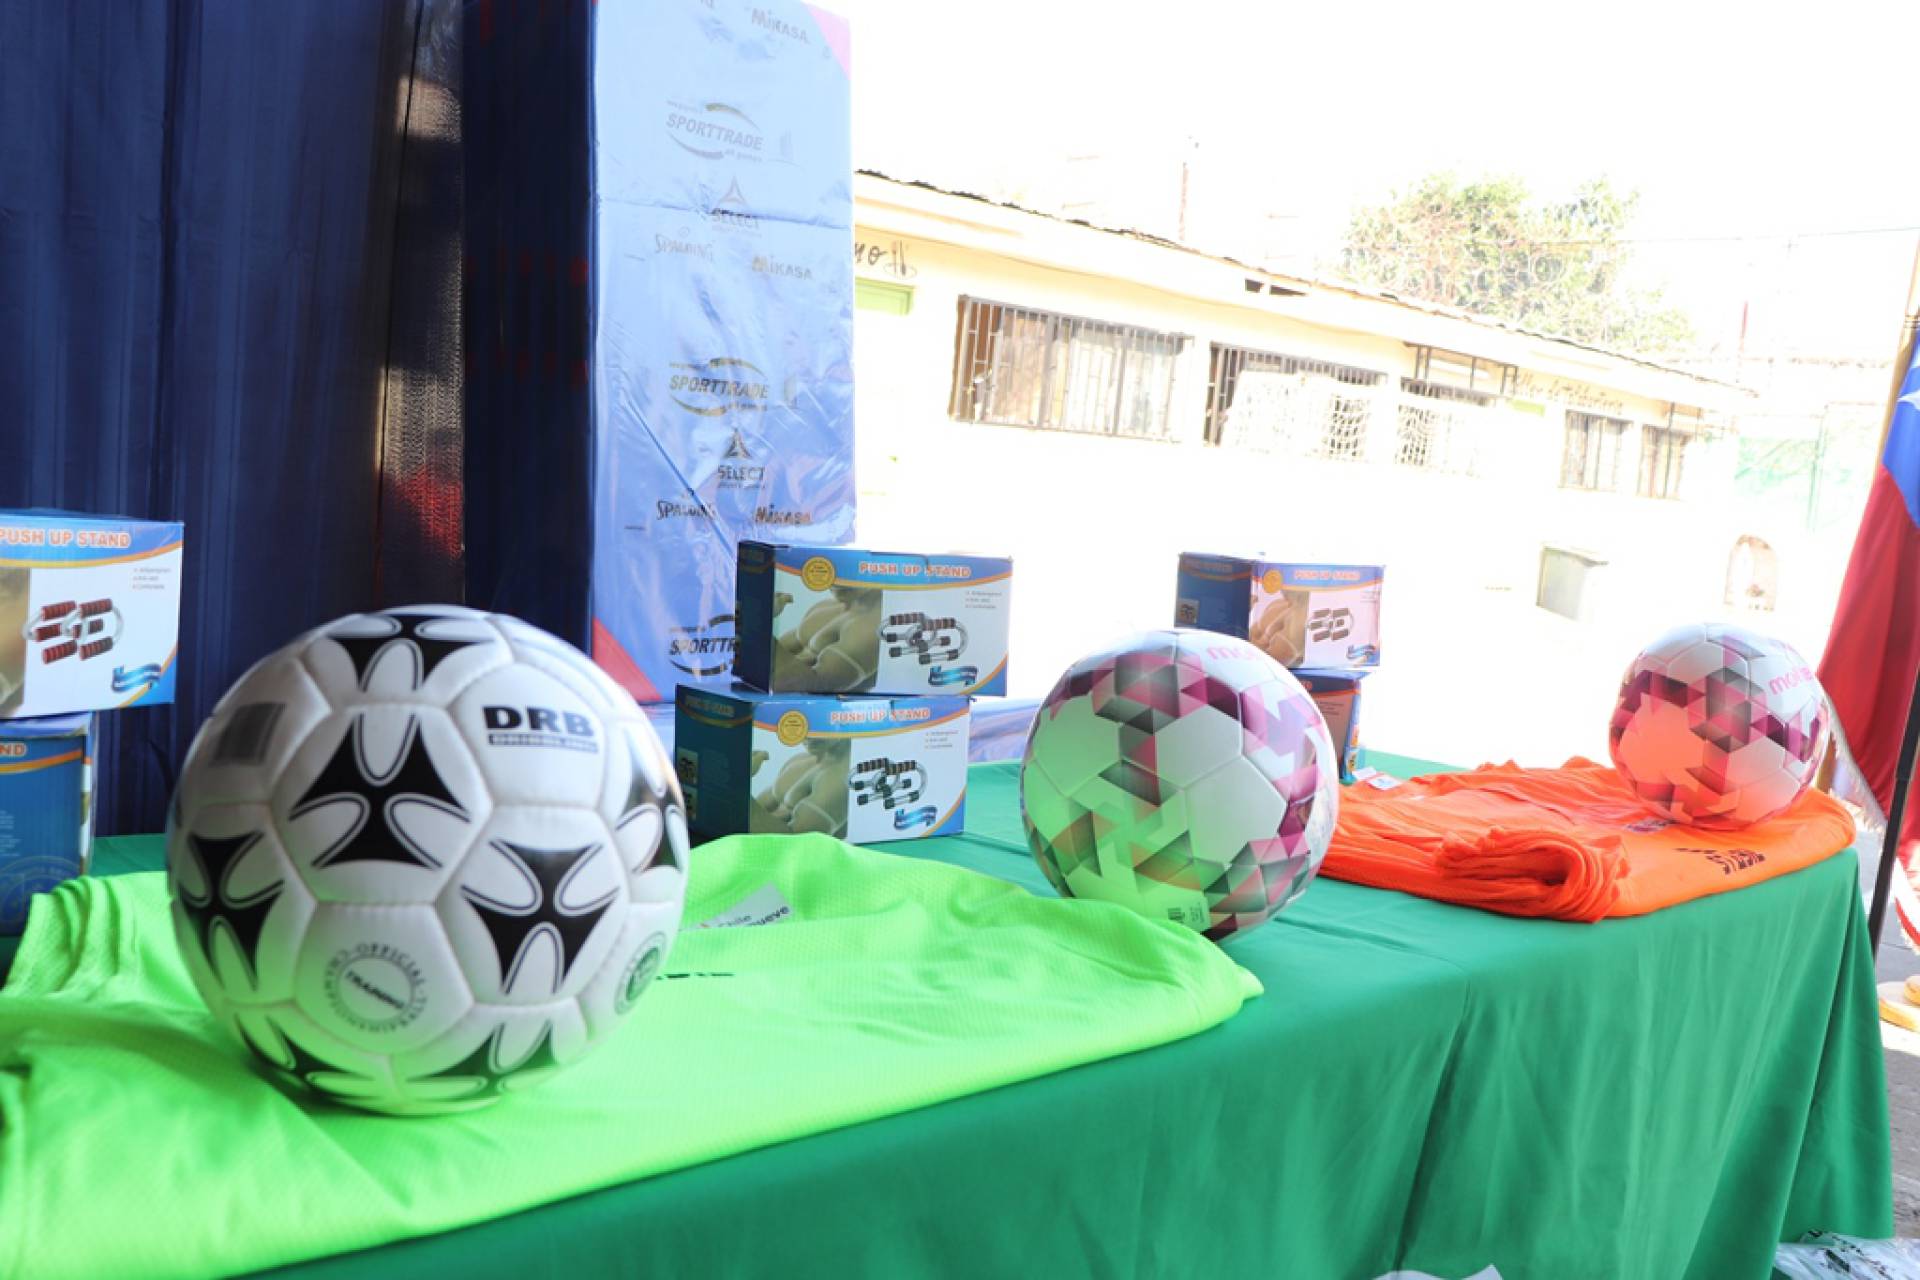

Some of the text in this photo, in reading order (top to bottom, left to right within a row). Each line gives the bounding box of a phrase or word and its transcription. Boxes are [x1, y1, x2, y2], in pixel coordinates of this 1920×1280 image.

[666, 113, 763, 151] SPORTTRADE
[669, 375, 769, 400] SPORTTRADE
[0, 528, 131, 548] PUSH UP STAND
[859, 561, 972, 578] PUSH UP STAND
[669, 637, 737, 655] SPORTTR
[483, 706, 594, 736] DRB
[830, 711, 866, 725] PUSH
[889, 707, 931, 722] STAND
